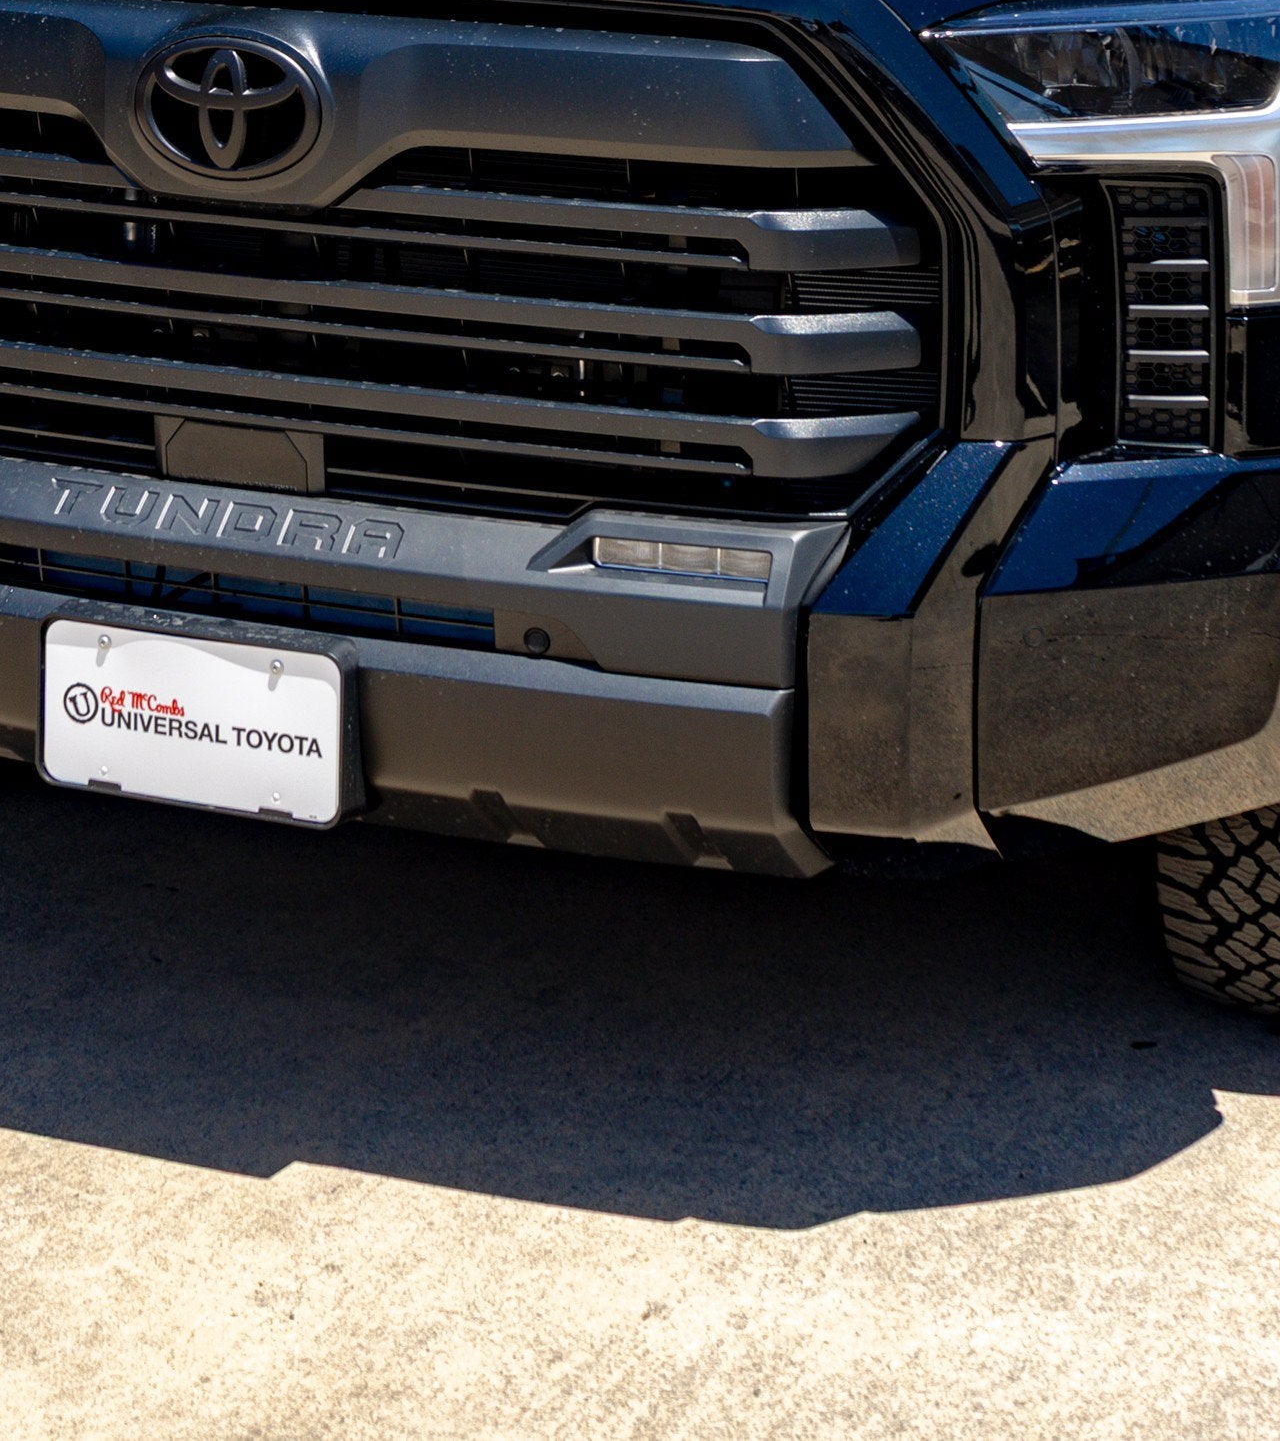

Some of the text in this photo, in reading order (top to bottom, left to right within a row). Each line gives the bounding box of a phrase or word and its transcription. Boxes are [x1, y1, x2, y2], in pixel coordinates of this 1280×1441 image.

[51, 476, 405, 559] TUNDRA
[100, 686, 126, 713] Red
[101, 707, 323, 759] UNIVERSAL TOYOTA
